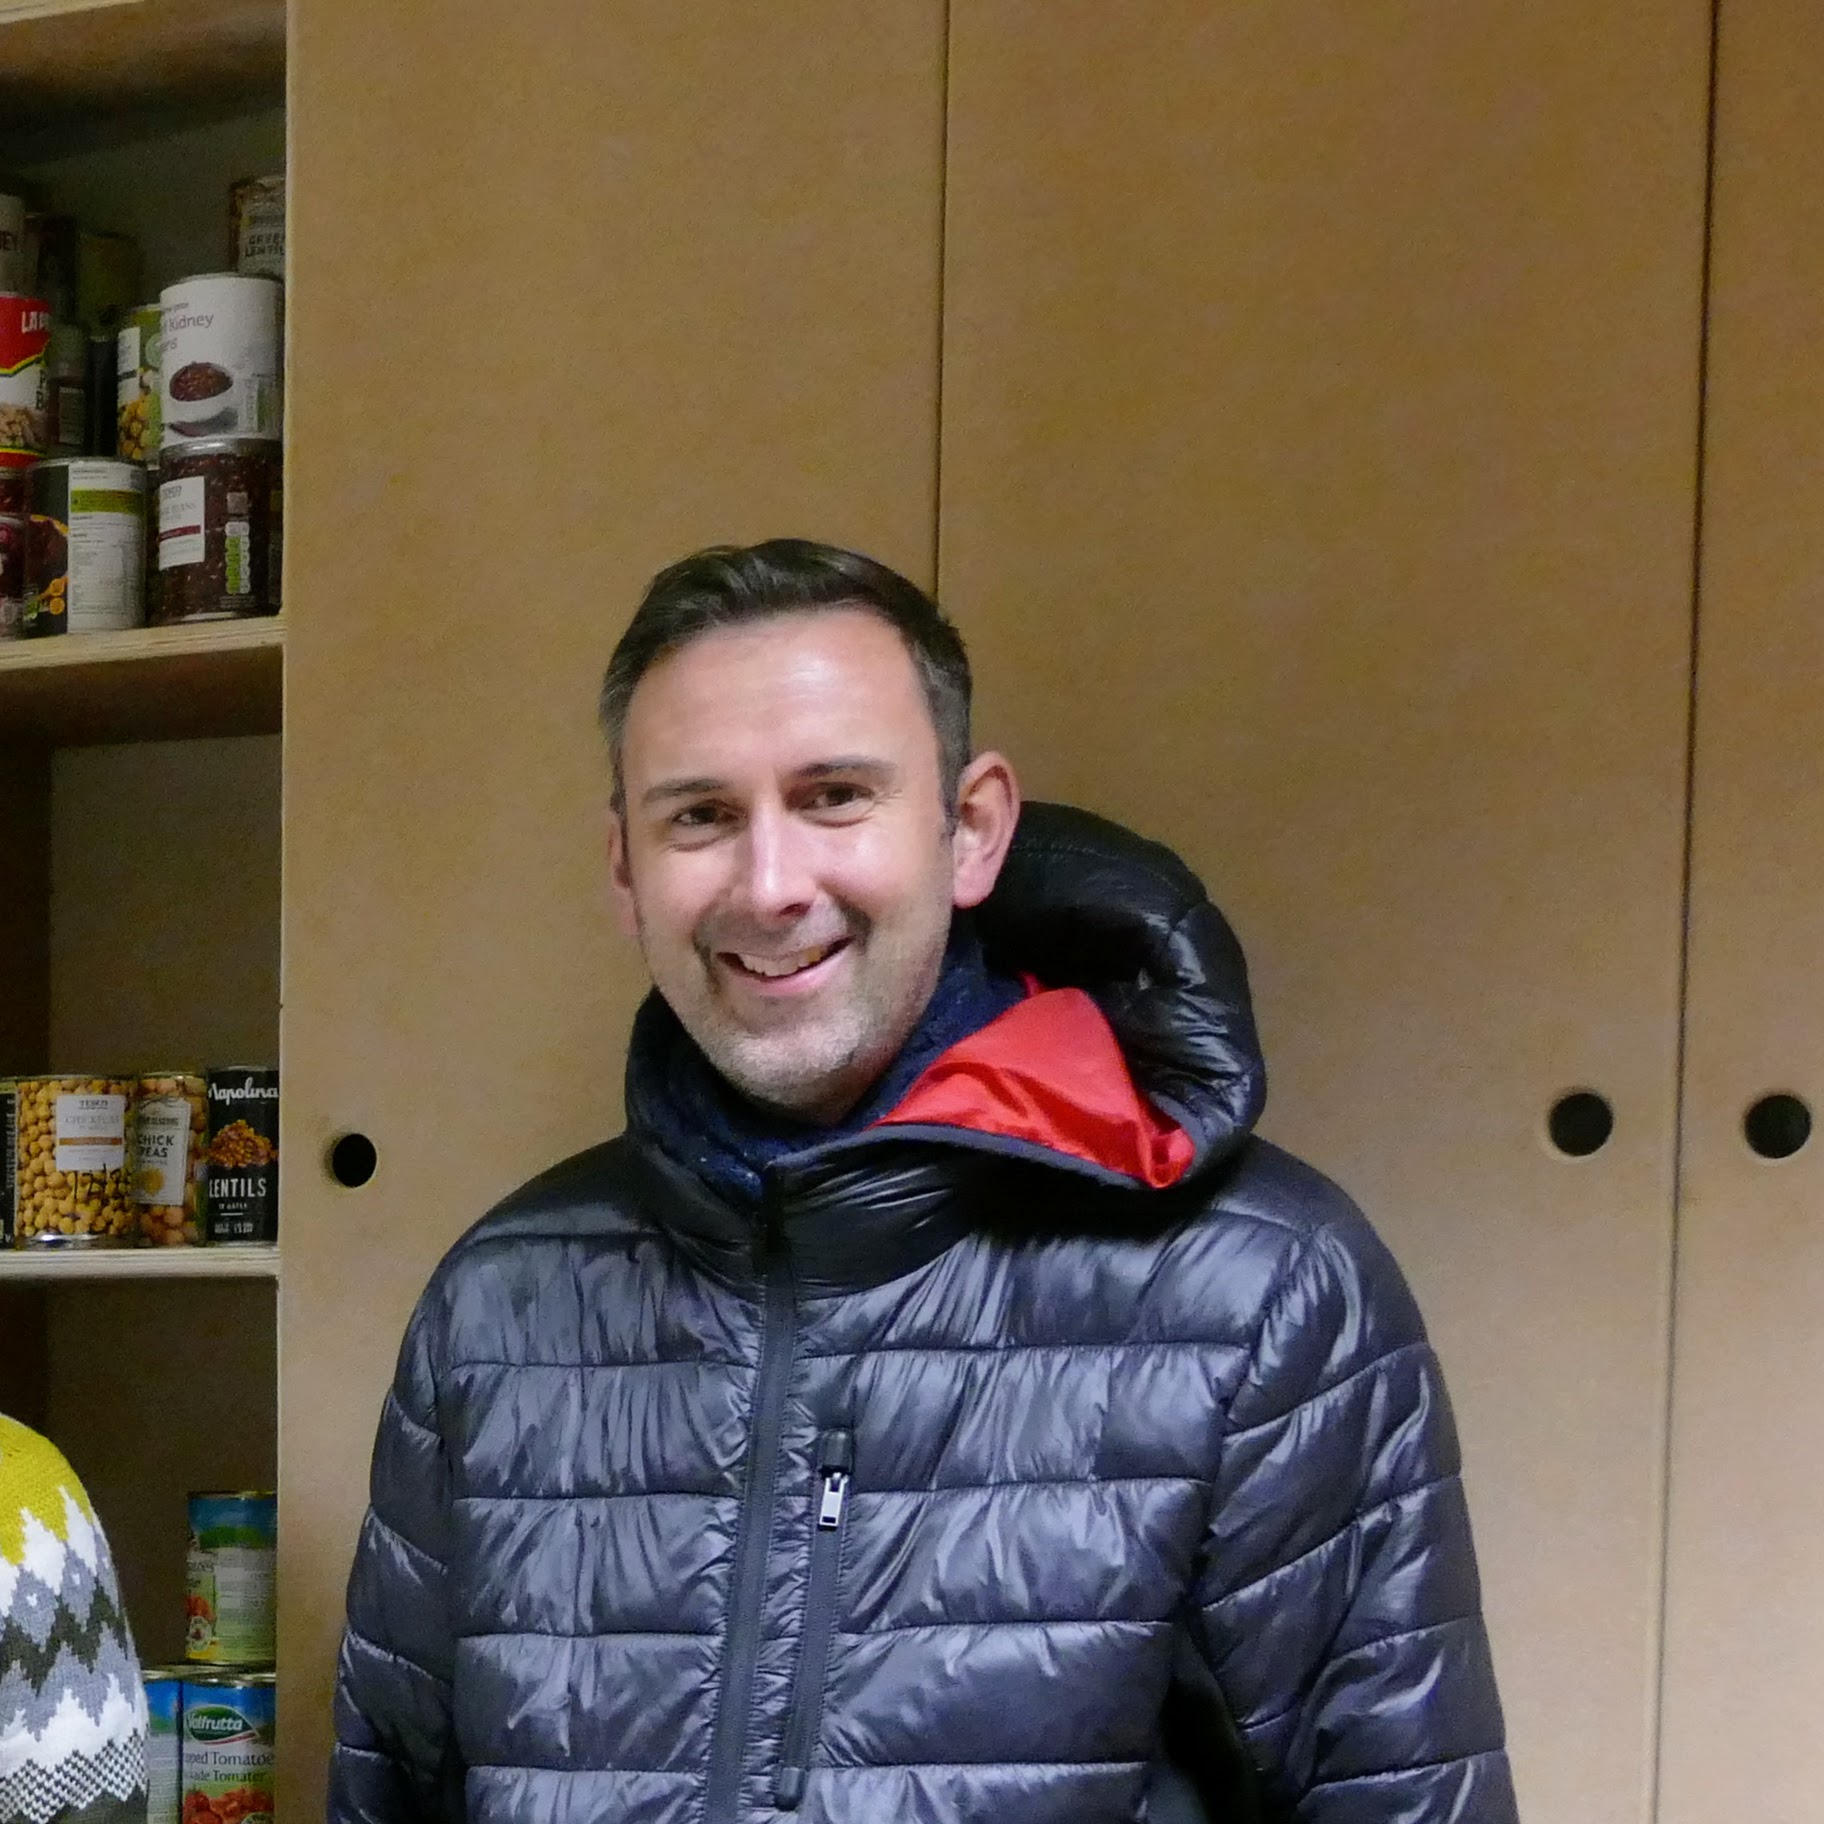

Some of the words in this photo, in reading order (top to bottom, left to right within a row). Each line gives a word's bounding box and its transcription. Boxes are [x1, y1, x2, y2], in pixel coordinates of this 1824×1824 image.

[248, 233, 286, 247] GREE
[245, 244, 286, 257] LENTIL
[209, 1178, 267, 1199] LENTILS
[212, 1751, 275, 1767] Tomatoe
